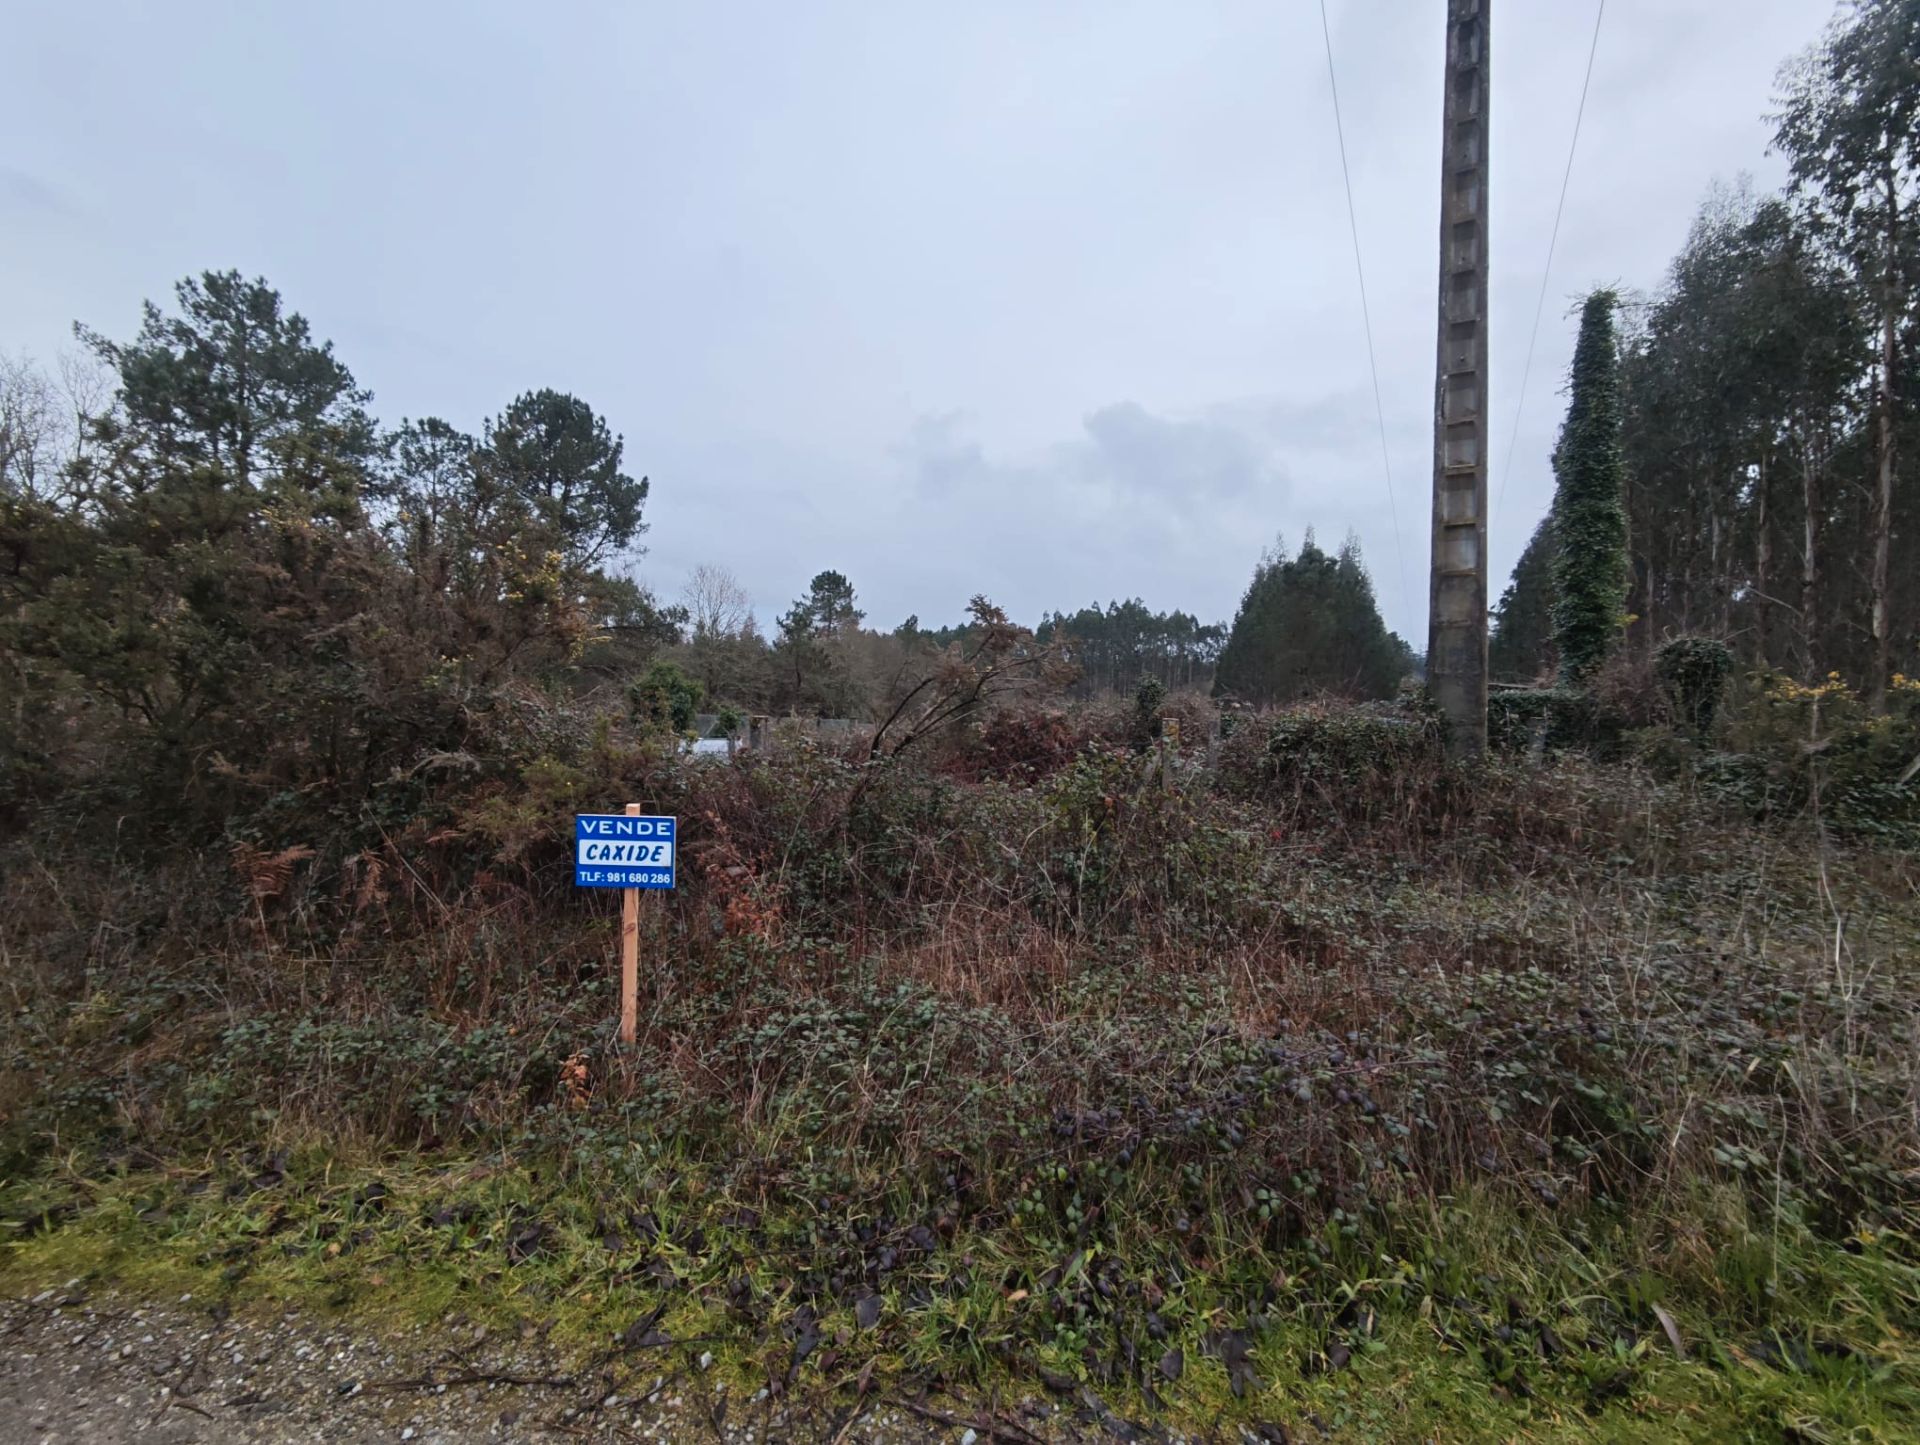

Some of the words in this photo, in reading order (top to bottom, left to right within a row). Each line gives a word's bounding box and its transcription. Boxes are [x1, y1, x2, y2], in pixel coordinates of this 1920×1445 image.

[581, 820, 671, 836] VENDE
[586, 844, 664, 862] CAXIDE
[580, 871, 605, 882] TLF:
[607, 872, 626, 883] 981
[629, 873, 648, 883] 680
[650, 874, 671, 884] 286
